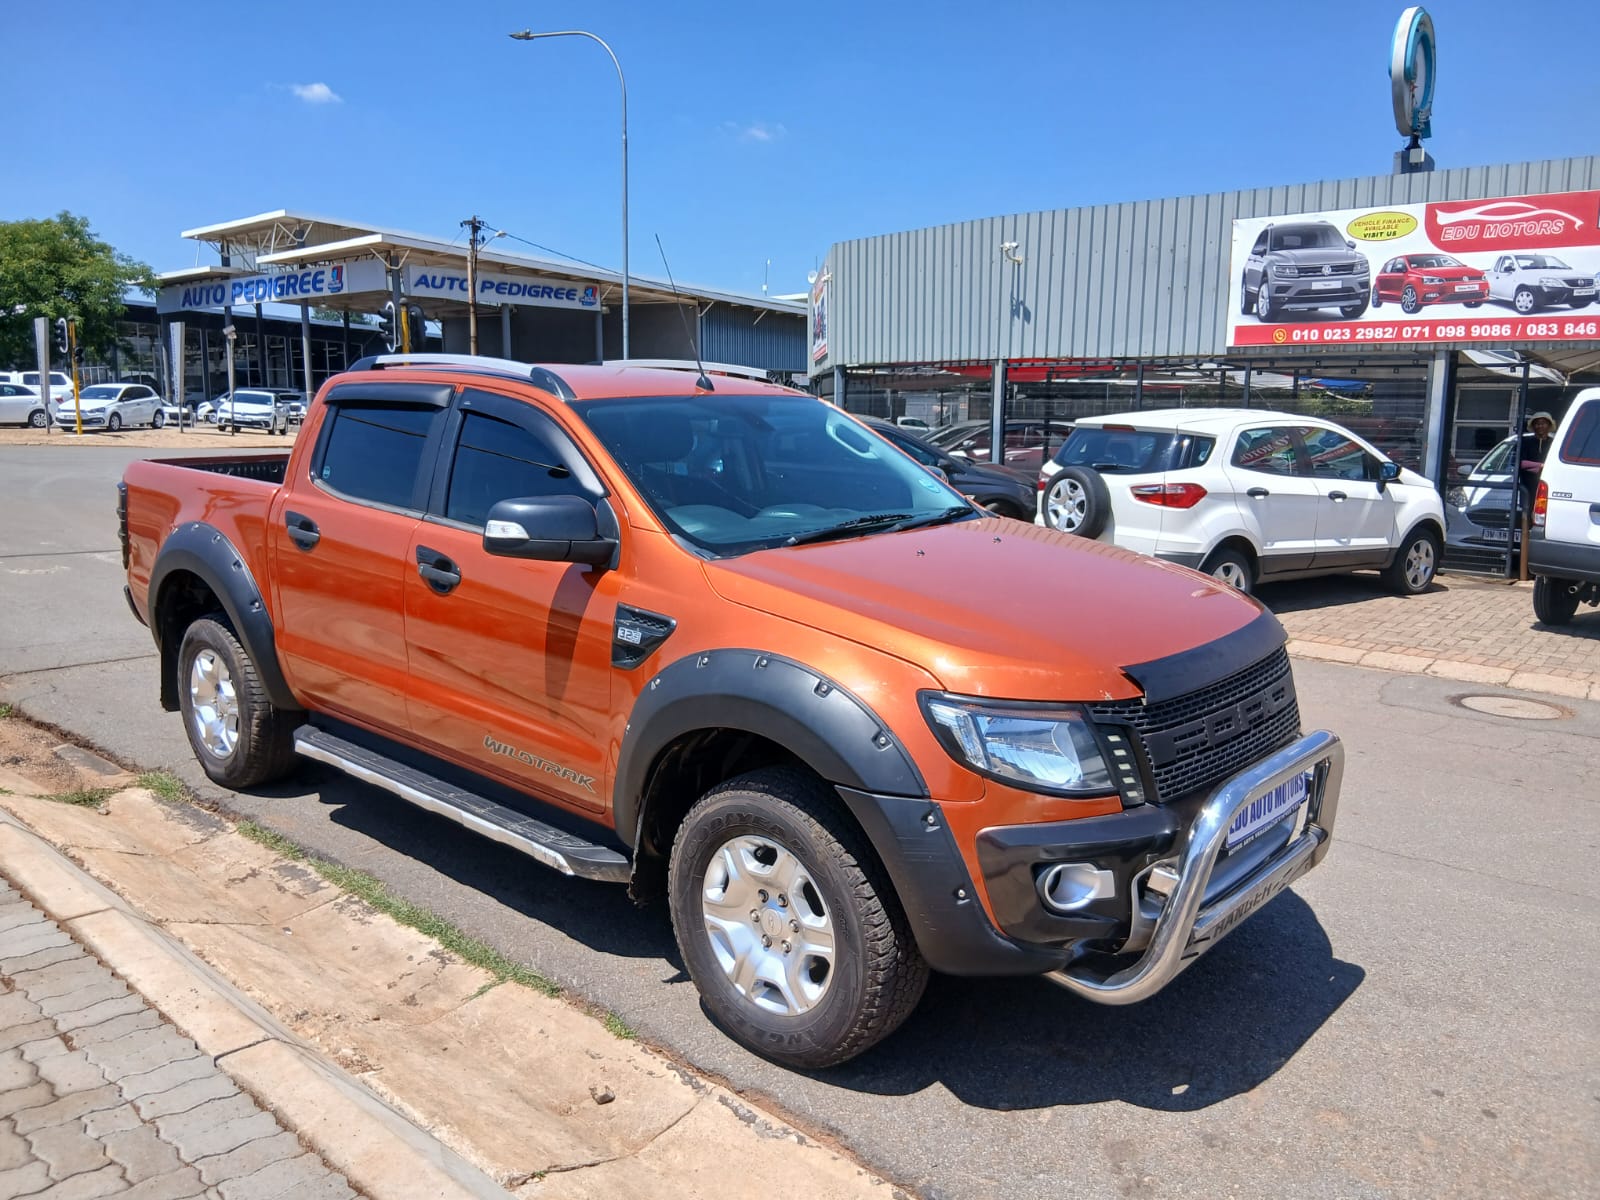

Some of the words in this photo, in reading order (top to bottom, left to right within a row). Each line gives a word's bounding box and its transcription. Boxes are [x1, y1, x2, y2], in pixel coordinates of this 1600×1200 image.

[1441, 224, 1480, 241] EDU
[1483, 219, 1565, 238] MOTORS
[181, 284, 226, 308] AUTO
[231, 270, 325, 302] PEDIGREE
[414, 274, 470, 292] AUTO
[480, 280, 578, 301] PEDIGREE
[1292, 329, 1319, 340] 010
[1323, 328, 1351, 340] 023
[1355, 327, 1398, 339] 2982/
[1402, 326, 1430, 338] 071
[1436, 325, 1466, 337] 098
[1470, 324, 1511, 337] 9086
[1515, 323, 1522, 336] /
[1526, 323, 1558, 336] 083
[1563, 322, 1597, 335] 846
[1142, 671, 1296, 765] FORD
[482, 735, 597, 794] WILDTRAK
[1250, 791, 1273, 823] AUTO
